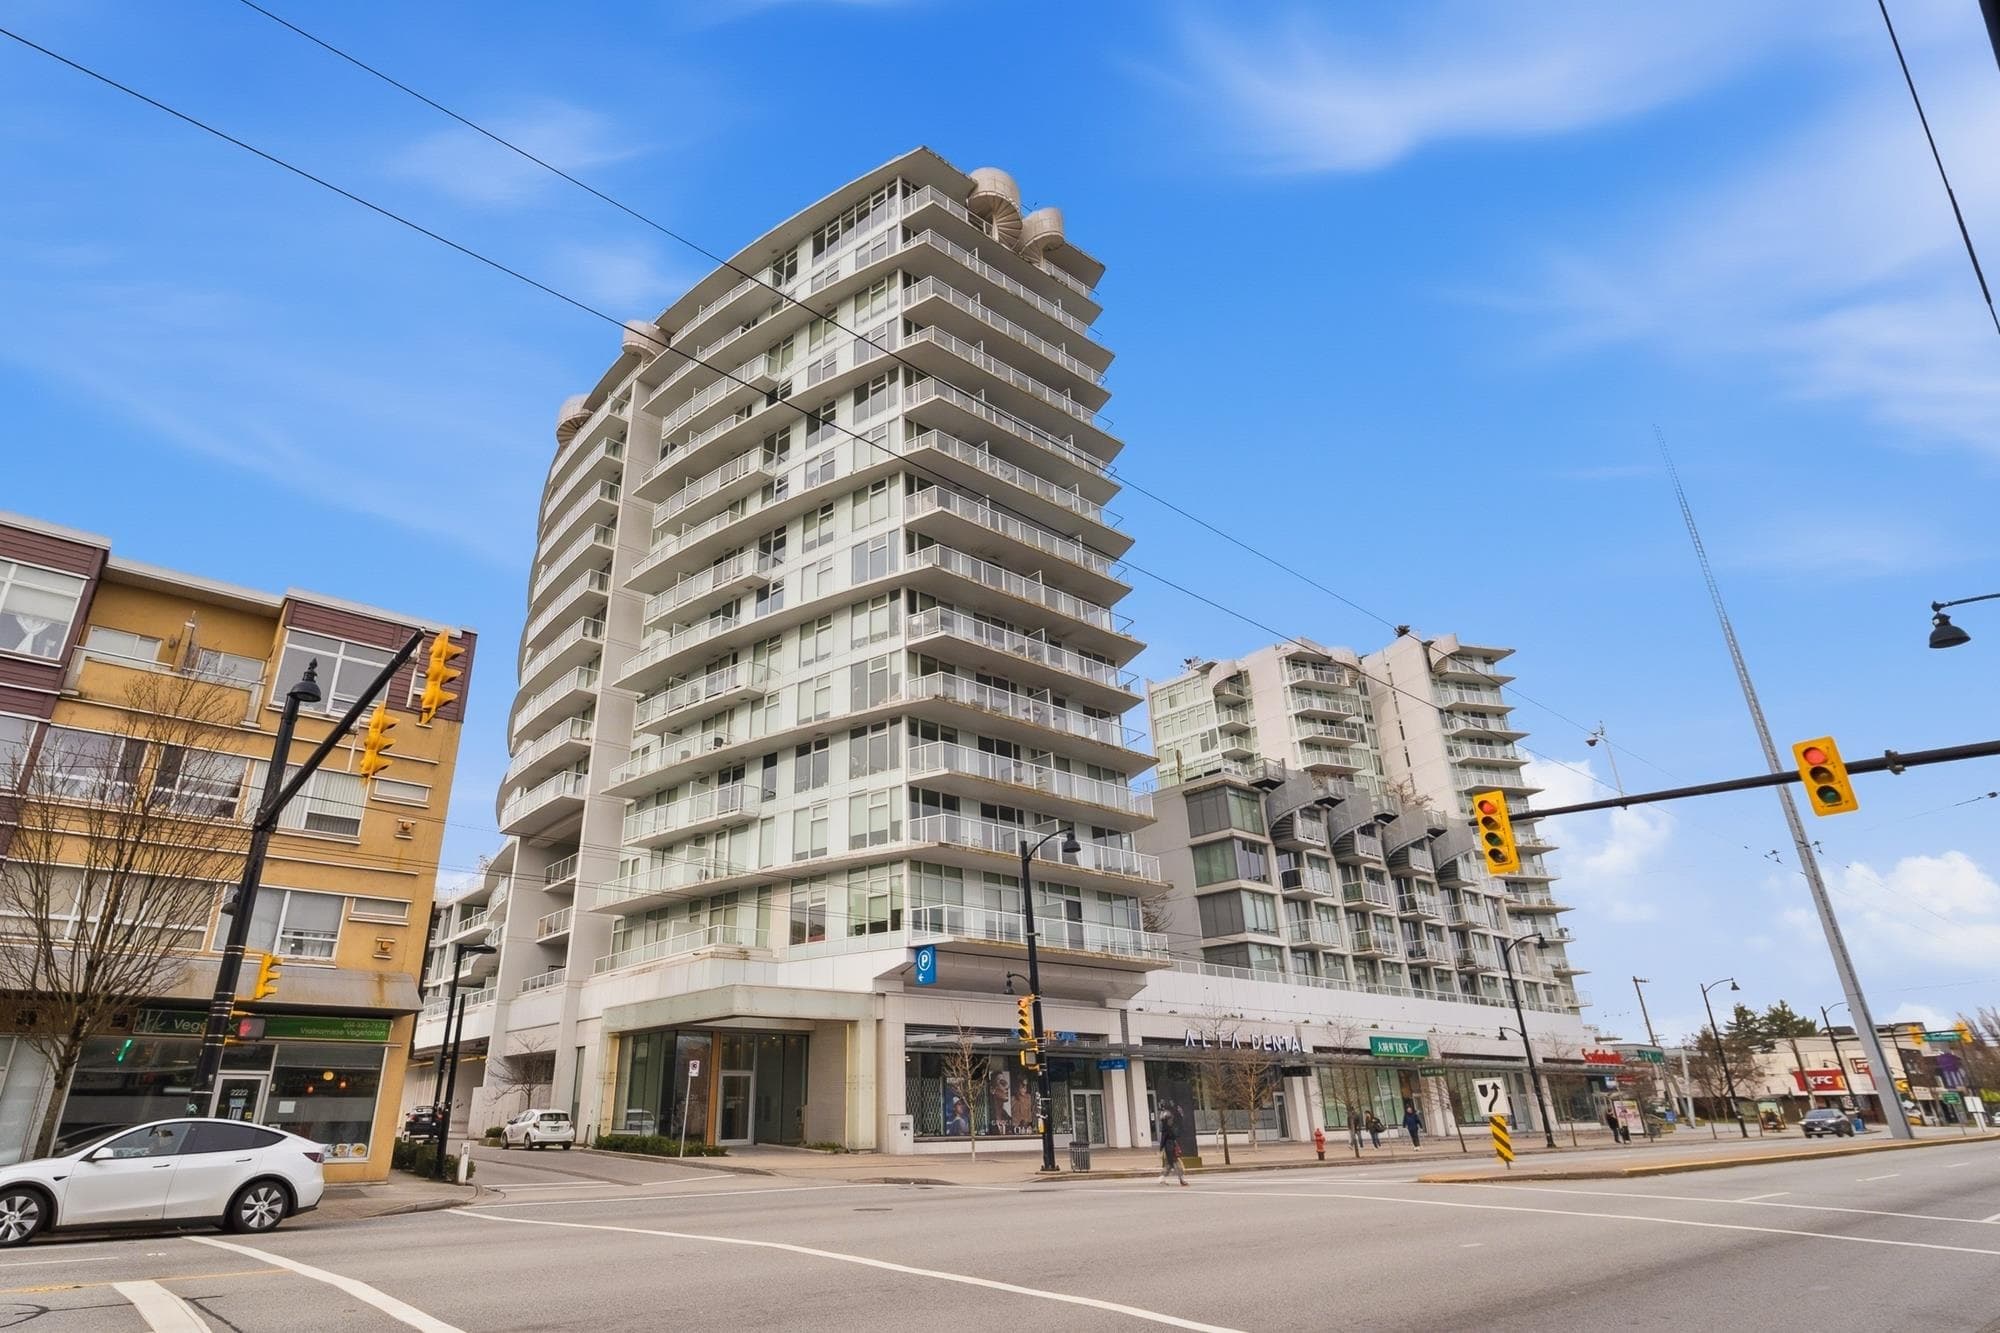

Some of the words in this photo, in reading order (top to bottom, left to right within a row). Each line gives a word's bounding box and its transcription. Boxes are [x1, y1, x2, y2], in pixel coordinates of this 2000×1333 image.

[346, 1027, 386, 1038] Vegetarian
[1250, 1033, 1307, 1053] DENTAL
[1808, 1075, 1833, 1085] KFC
